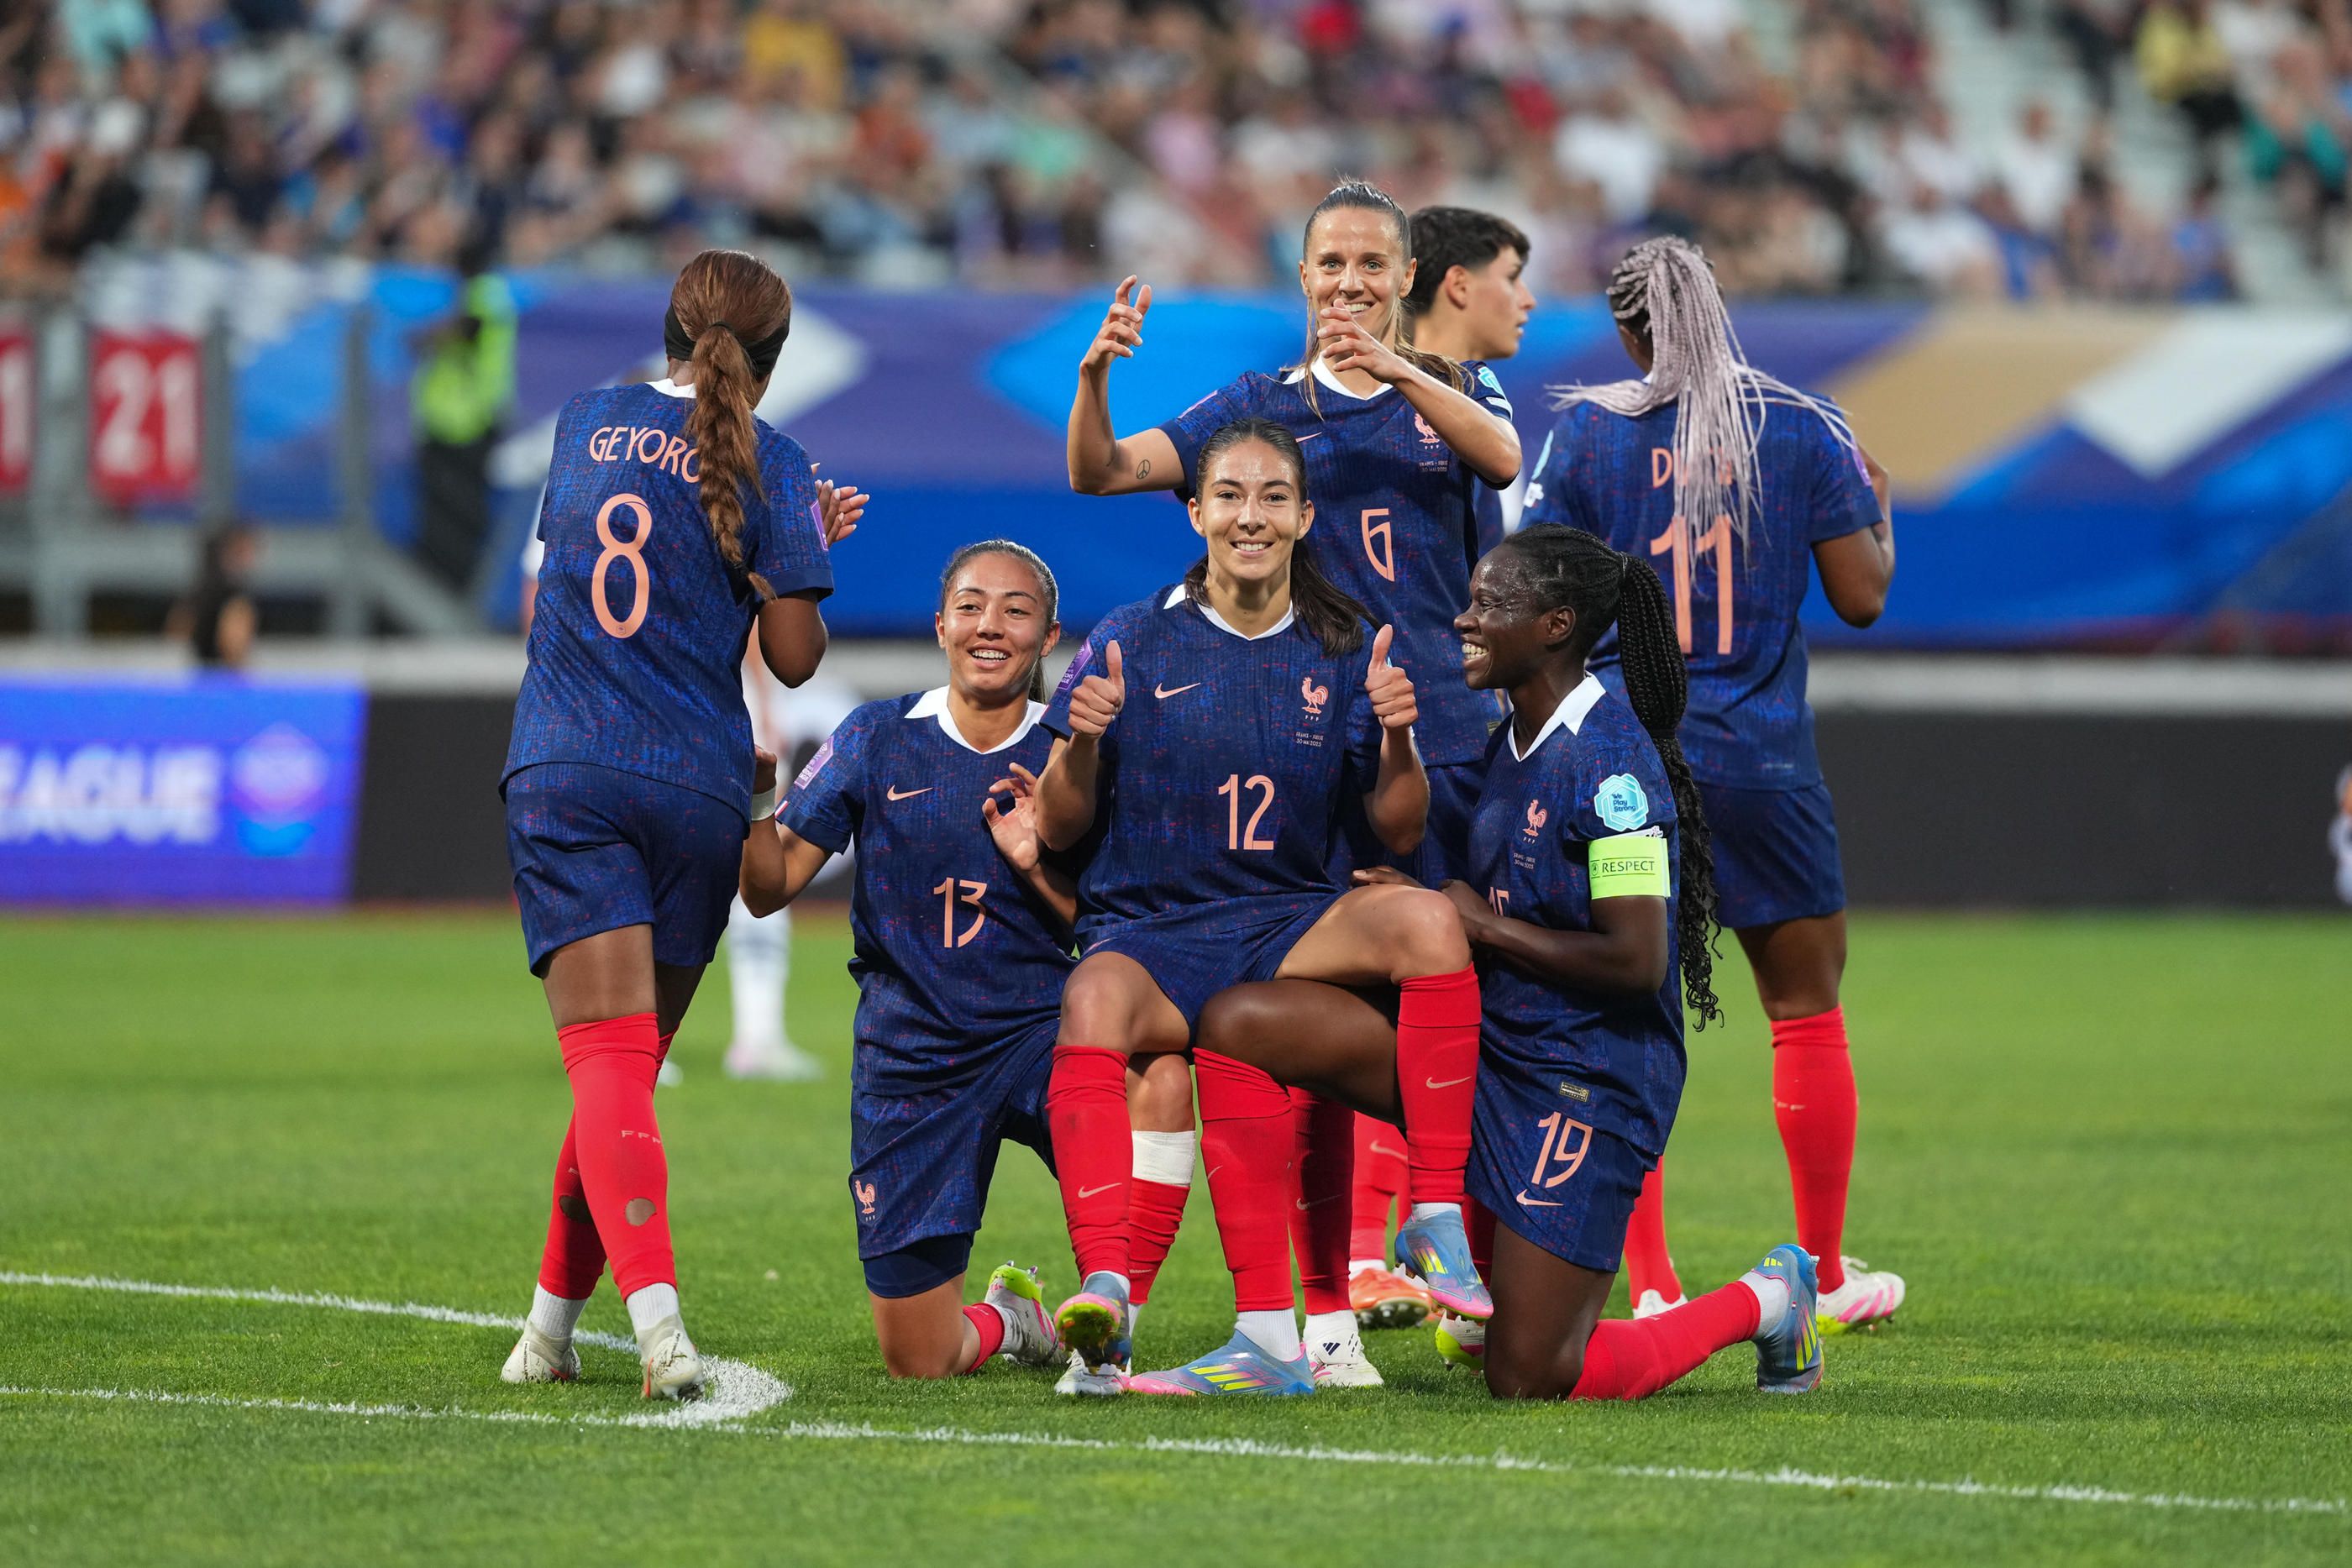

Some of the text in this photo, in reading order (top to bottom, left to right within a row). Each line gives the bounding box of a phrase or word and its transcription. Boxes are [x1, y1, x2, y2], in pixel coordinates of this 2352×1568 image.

[96, 349, 198, 474] 21
[591, 493, 652, 638] 8
[1362, 507, 1394, 582] 6
[1650, 515, 1734, 654] 11
[1218, 774, 1275, 850] 12
[1602, 860, 1655, 873] RESPECT
[933, 877, 988, 947] 13
[1531, 1111, 1593, 1188] 19
